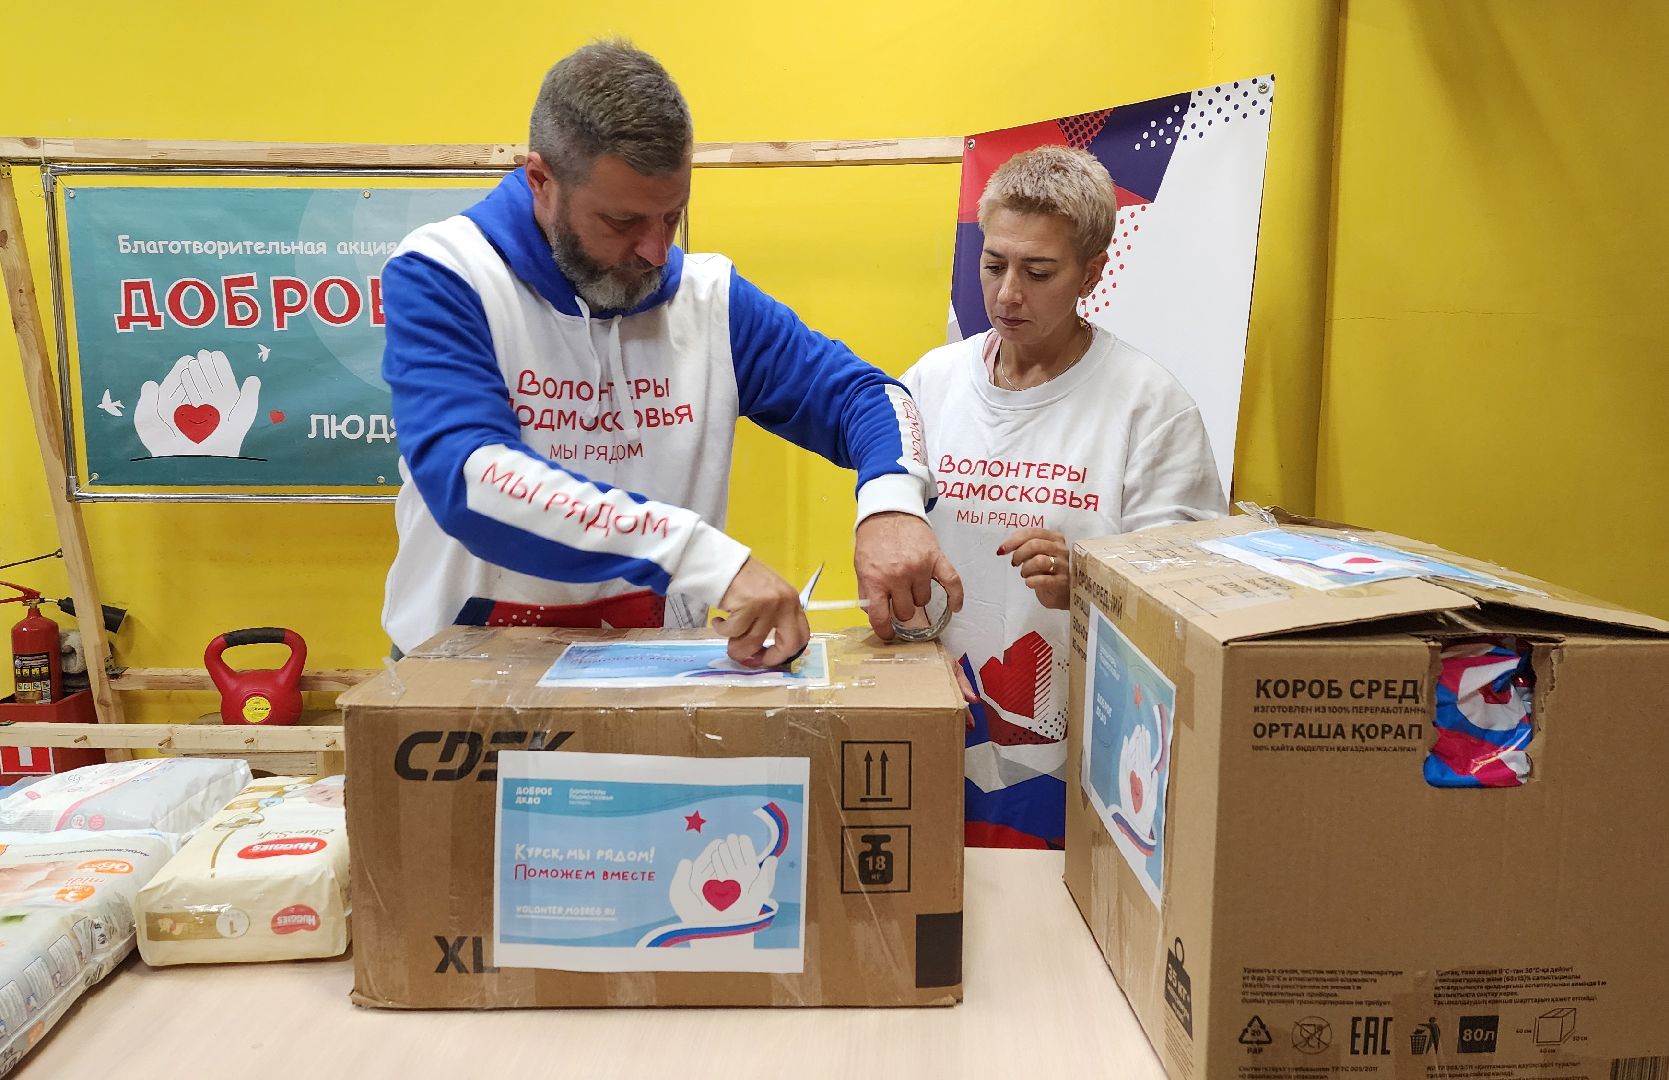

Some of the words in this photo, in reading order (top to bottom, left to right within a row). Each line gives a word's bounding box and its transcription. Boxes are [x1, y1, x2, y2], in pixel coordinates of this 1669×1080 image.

[118, 235, 327, 260] Благотворительная
[550, 443, 578, 460] МЫ
[584, 443, 644, 464] РЯДОМ
[938, 454, 1088, 484] ВОЛОНТЕРЫ
[480, 462, 543, 505] МЫ
[544, 491, 669, 539] РЯДОМ
[937, 480, 1100, 512] ОДМОСКОВЬЯ
[956, 509, 984, 525] МЫ
[988, 511, 1045, 528] РЯДОМ
[1255, 679, 1343, 699] КОРОБ
[1254, 705, 1313, 714] ИЗГОТОВЛЕН
[1314, 706, 1327, 714] ИЗ
[1253, 722, 1346, 739] ОРТАША
[1352, 724, 1423, 743] ҚОРАП
[865, 855, 886, 871] 18
[434, 935, 500, 974] XL
[1350, 1016, 1394, 1055] EAC
[1462, 1028, 1495, 1042] 80л
